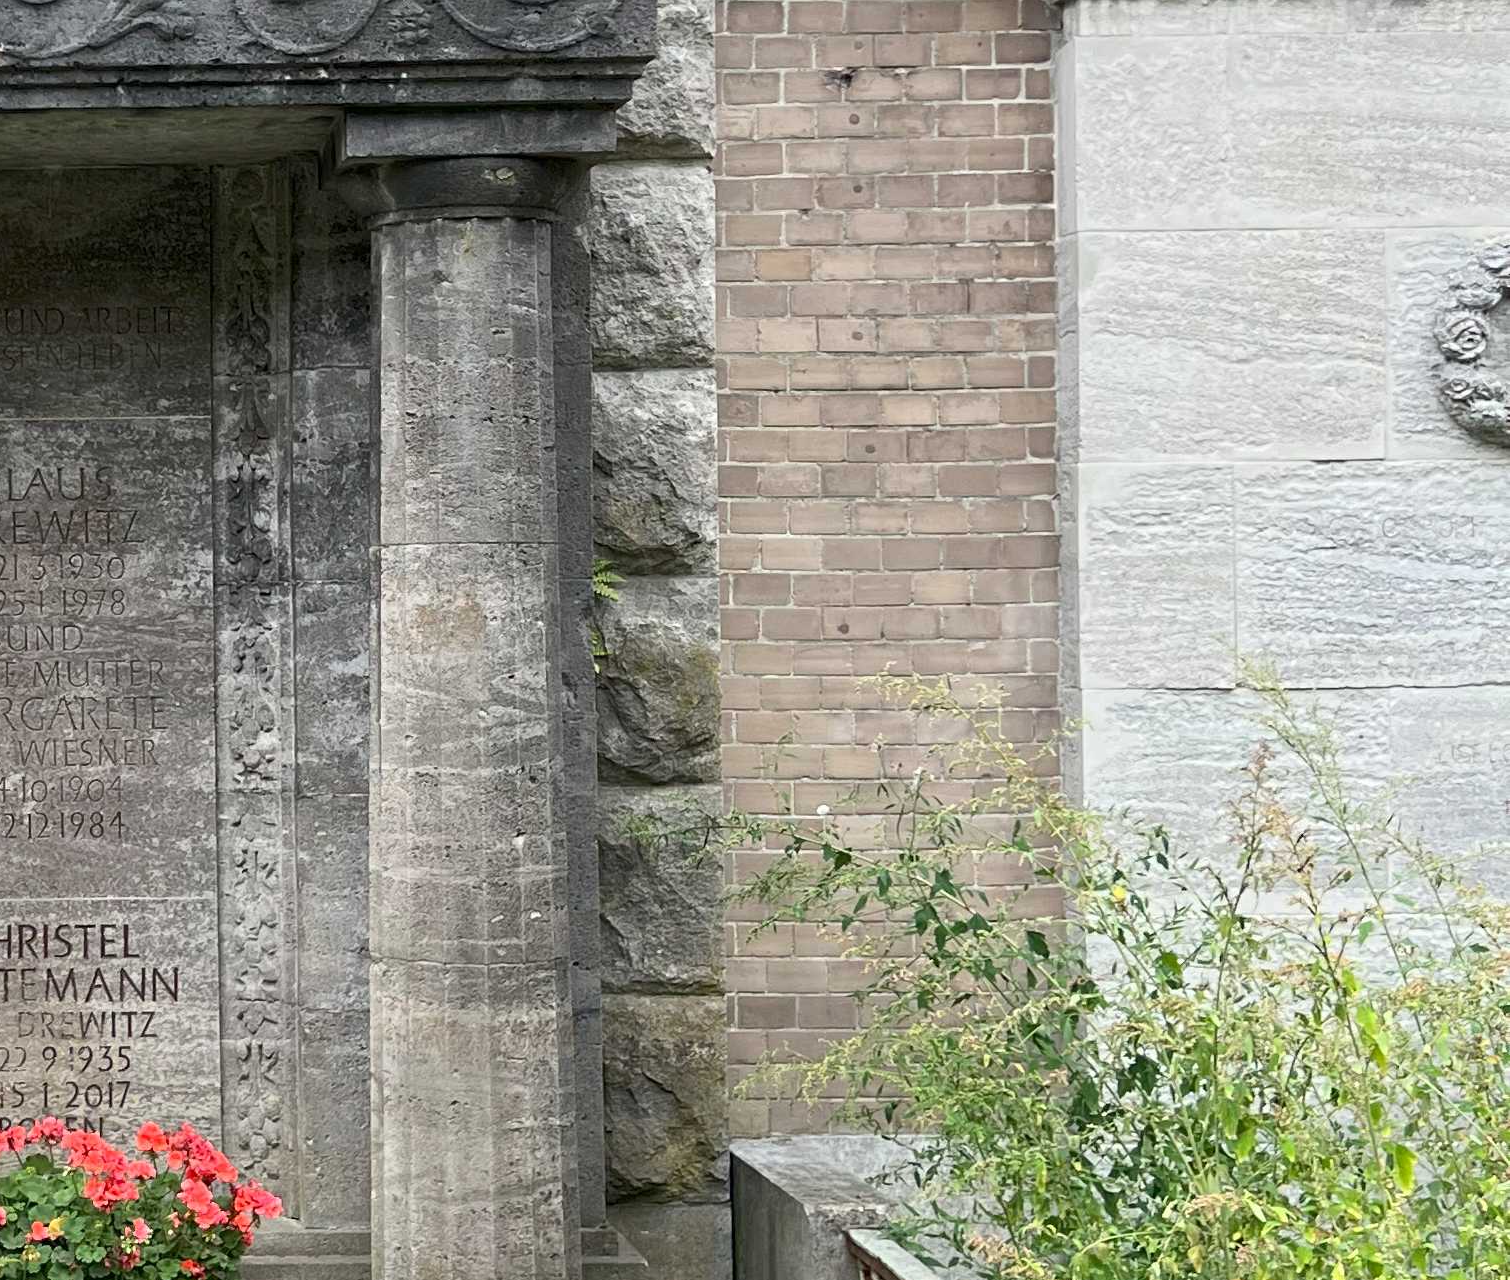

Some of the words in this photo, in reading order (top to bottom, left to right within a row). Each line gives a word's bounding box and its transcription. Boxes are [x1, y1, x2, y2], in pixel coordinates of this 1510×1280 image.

[3, 306, 66, 336] UND
[6, 624, 85, 652] UND
[32, 659, 167, 689] MUTTER
[17, 737, 161, 767] WIESNER
[17, 1010, 160, 1040] DREWITZ
